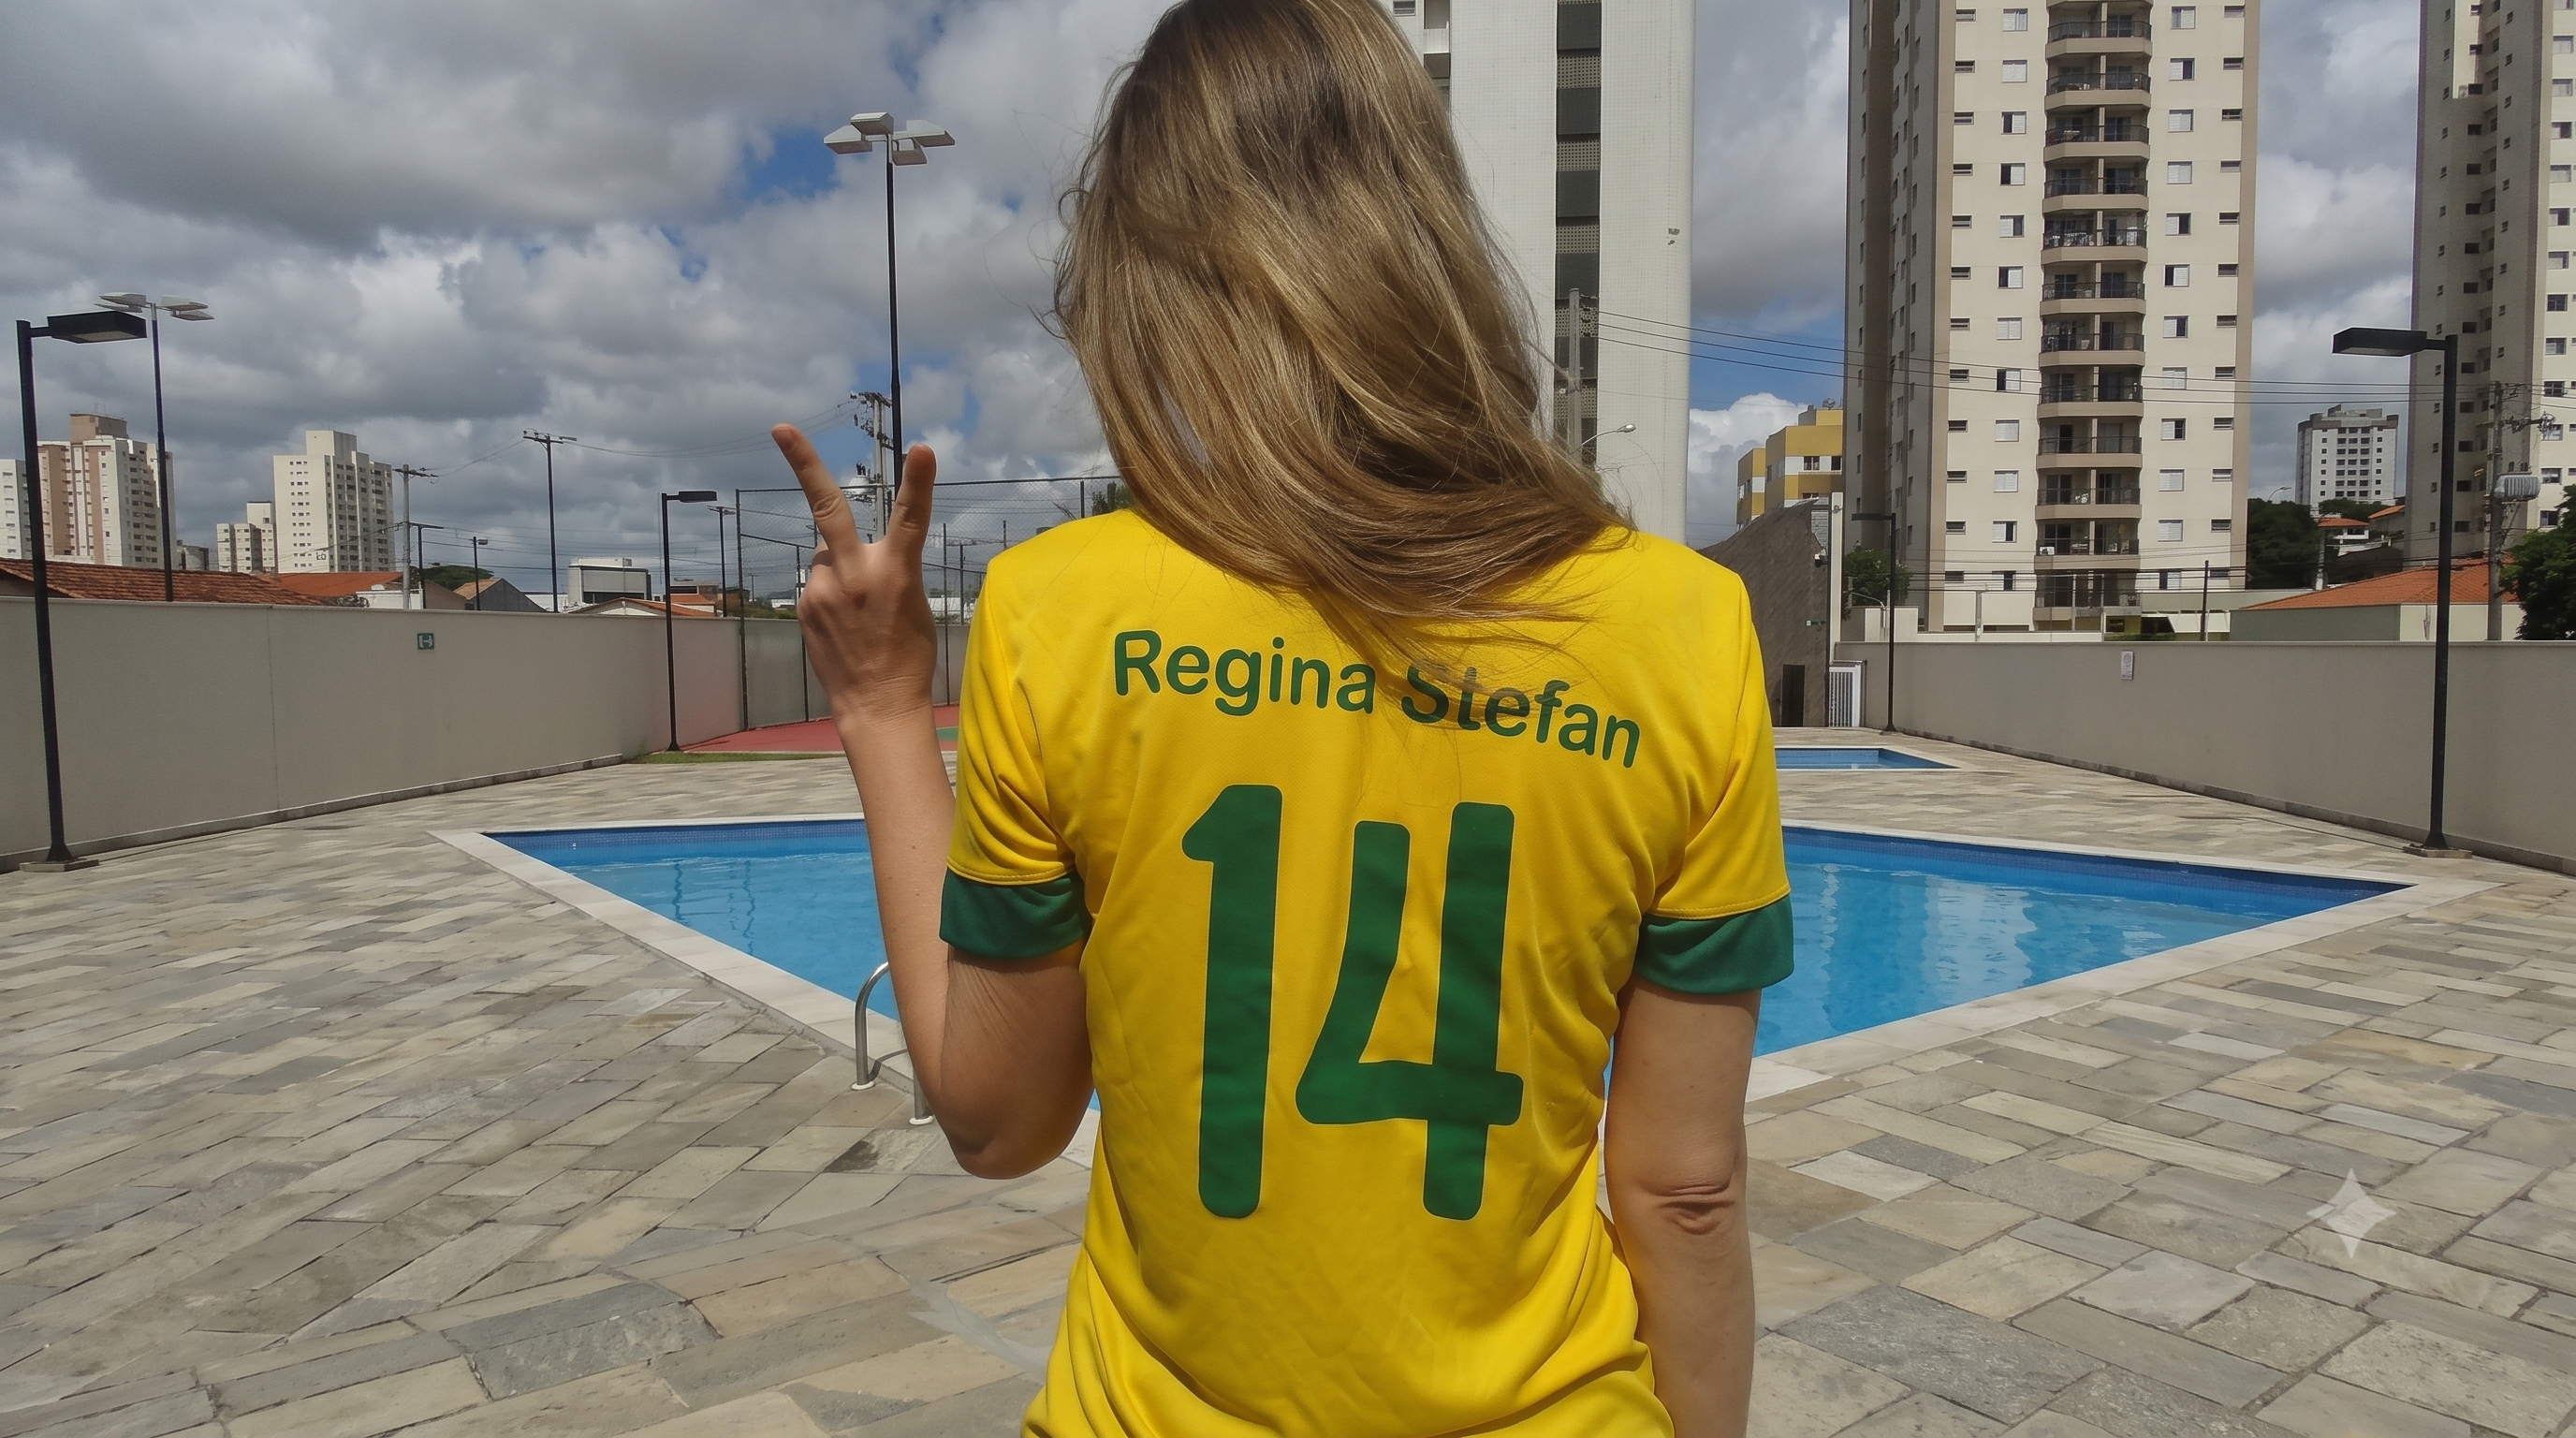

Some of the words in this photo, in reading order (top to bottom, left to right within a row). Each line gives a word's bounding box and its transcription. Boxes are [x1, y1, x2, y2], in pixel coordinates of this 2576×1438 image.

[1114, 629, 1376, 716] Regina
[1400, 660, 1640, 768] Stefan
[1181, 784, 1524, 1221] 14
